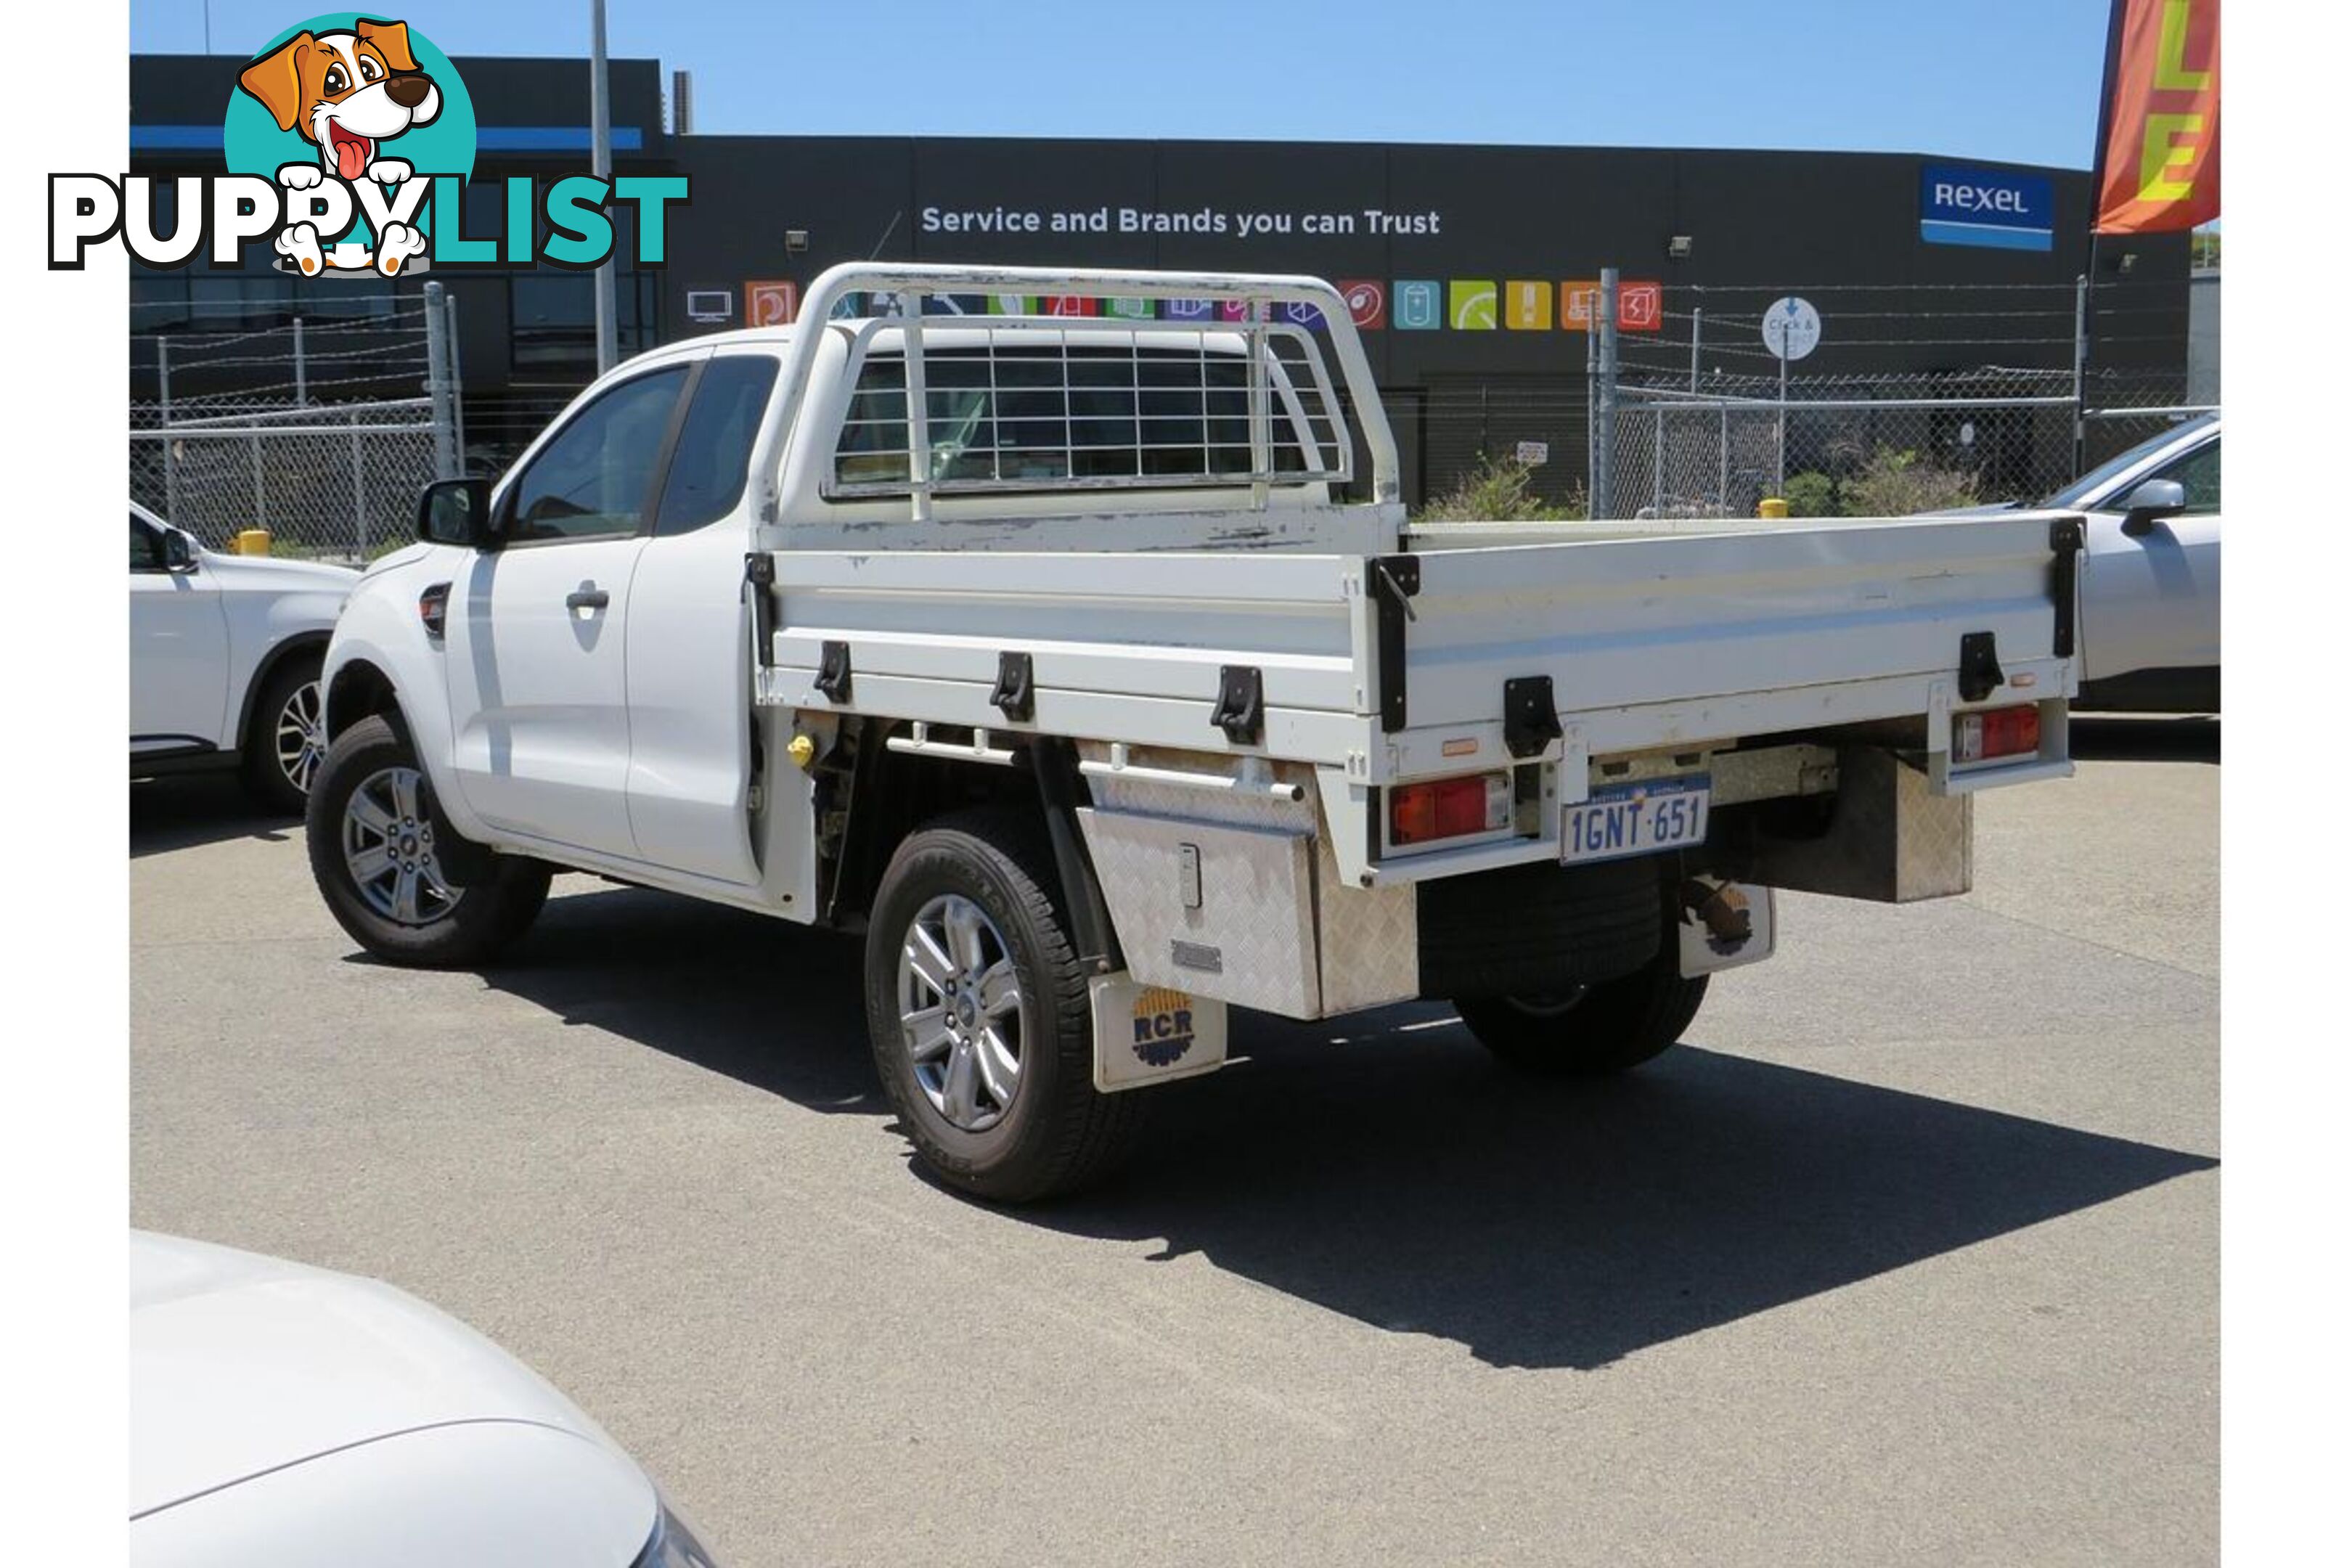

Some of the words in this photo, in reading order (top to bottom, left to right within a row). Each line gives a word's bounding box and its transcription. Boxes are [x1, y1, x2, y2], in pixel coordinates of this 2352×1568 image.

[921, 207, 1040, 232] Service
[1050, 207, 1108, 232] and
[1119, 207, 1227, 232] Brands
[1236, 213, 1292, 237] you
[1301, 213, 1355, 234] can
[1363, 210, 1440, 234] Trust
[1135, 1010, 1193, 1042] RCR
